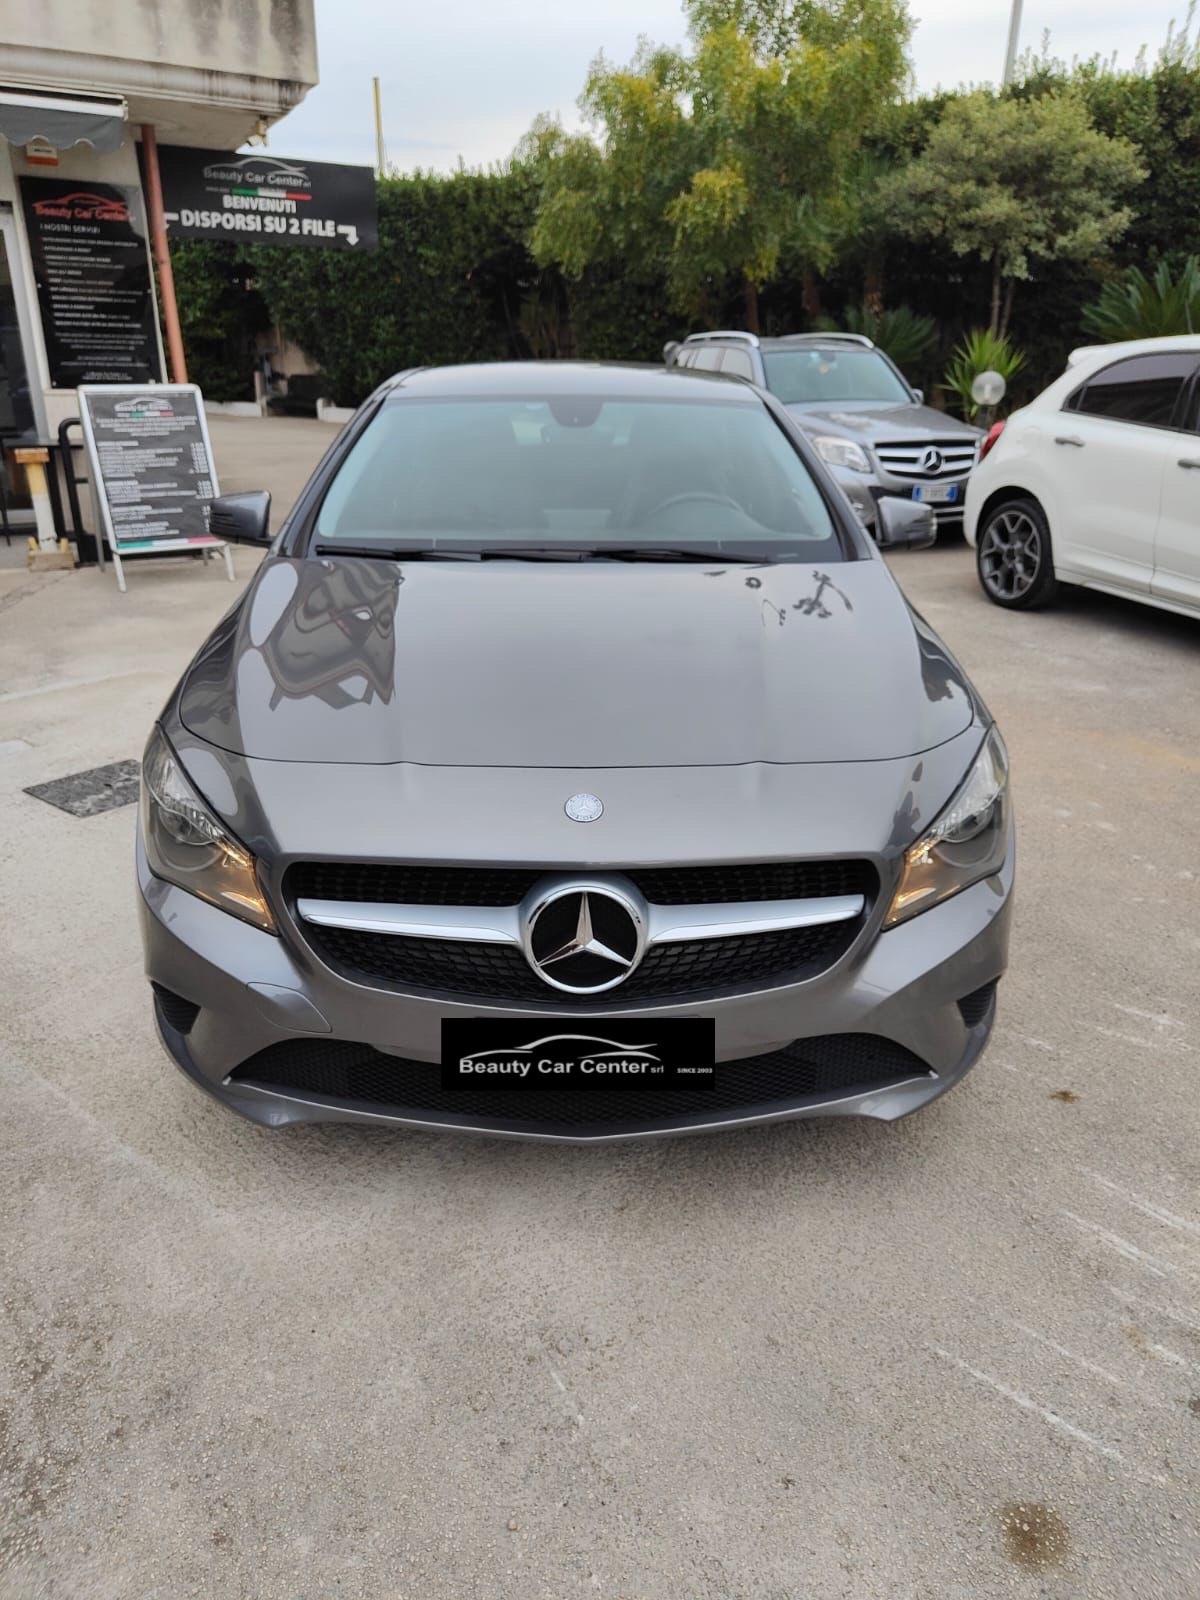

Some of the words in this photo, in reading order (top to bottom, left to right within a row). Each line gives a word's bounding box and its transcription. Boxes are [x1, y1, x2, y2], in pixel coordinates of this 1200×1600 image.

[203, 168, 243, 184] Beauty
[245, 173, 265, 184] Car
[268, 174, 303, 187] Center
[74, 208, 92, 218] Car
[223, 195, 297, 213] BENVENUTI
[43, 223, 71, 233] NOSTRI
[181, 209, 262, 232] DISPORSI
[263, 216, 286, 233] SU
[289, 218, 300, 235] 2
[302, 219, 336, 237] FILE
